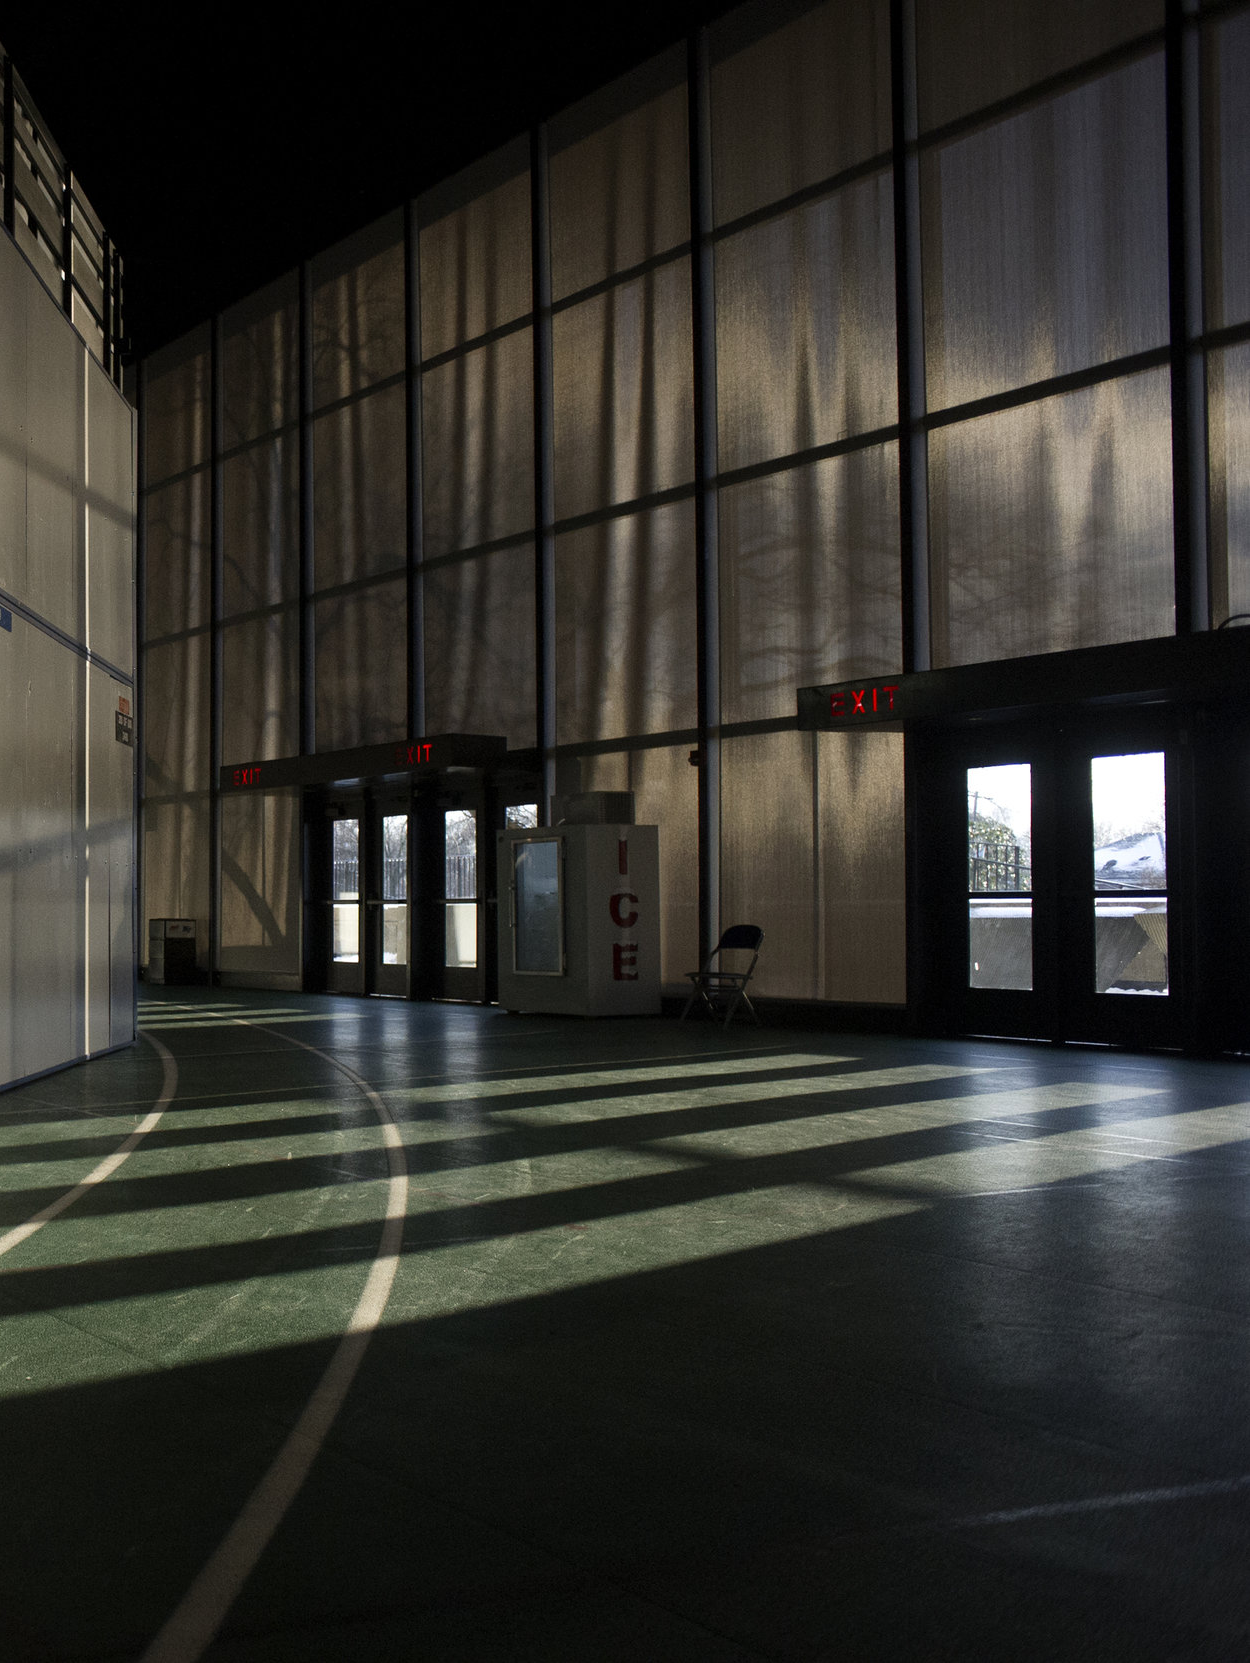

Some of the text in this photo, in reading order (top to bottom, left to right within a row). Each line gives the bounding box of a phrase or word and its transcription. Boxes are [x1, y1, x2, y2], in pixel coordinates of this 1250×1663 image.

[830, 685, 900, 717] EXIT
[395, 743, 434, 767] EXIT
[232, 767, 263, 787] EXIT
[609, 839, 639, 981] ICE
